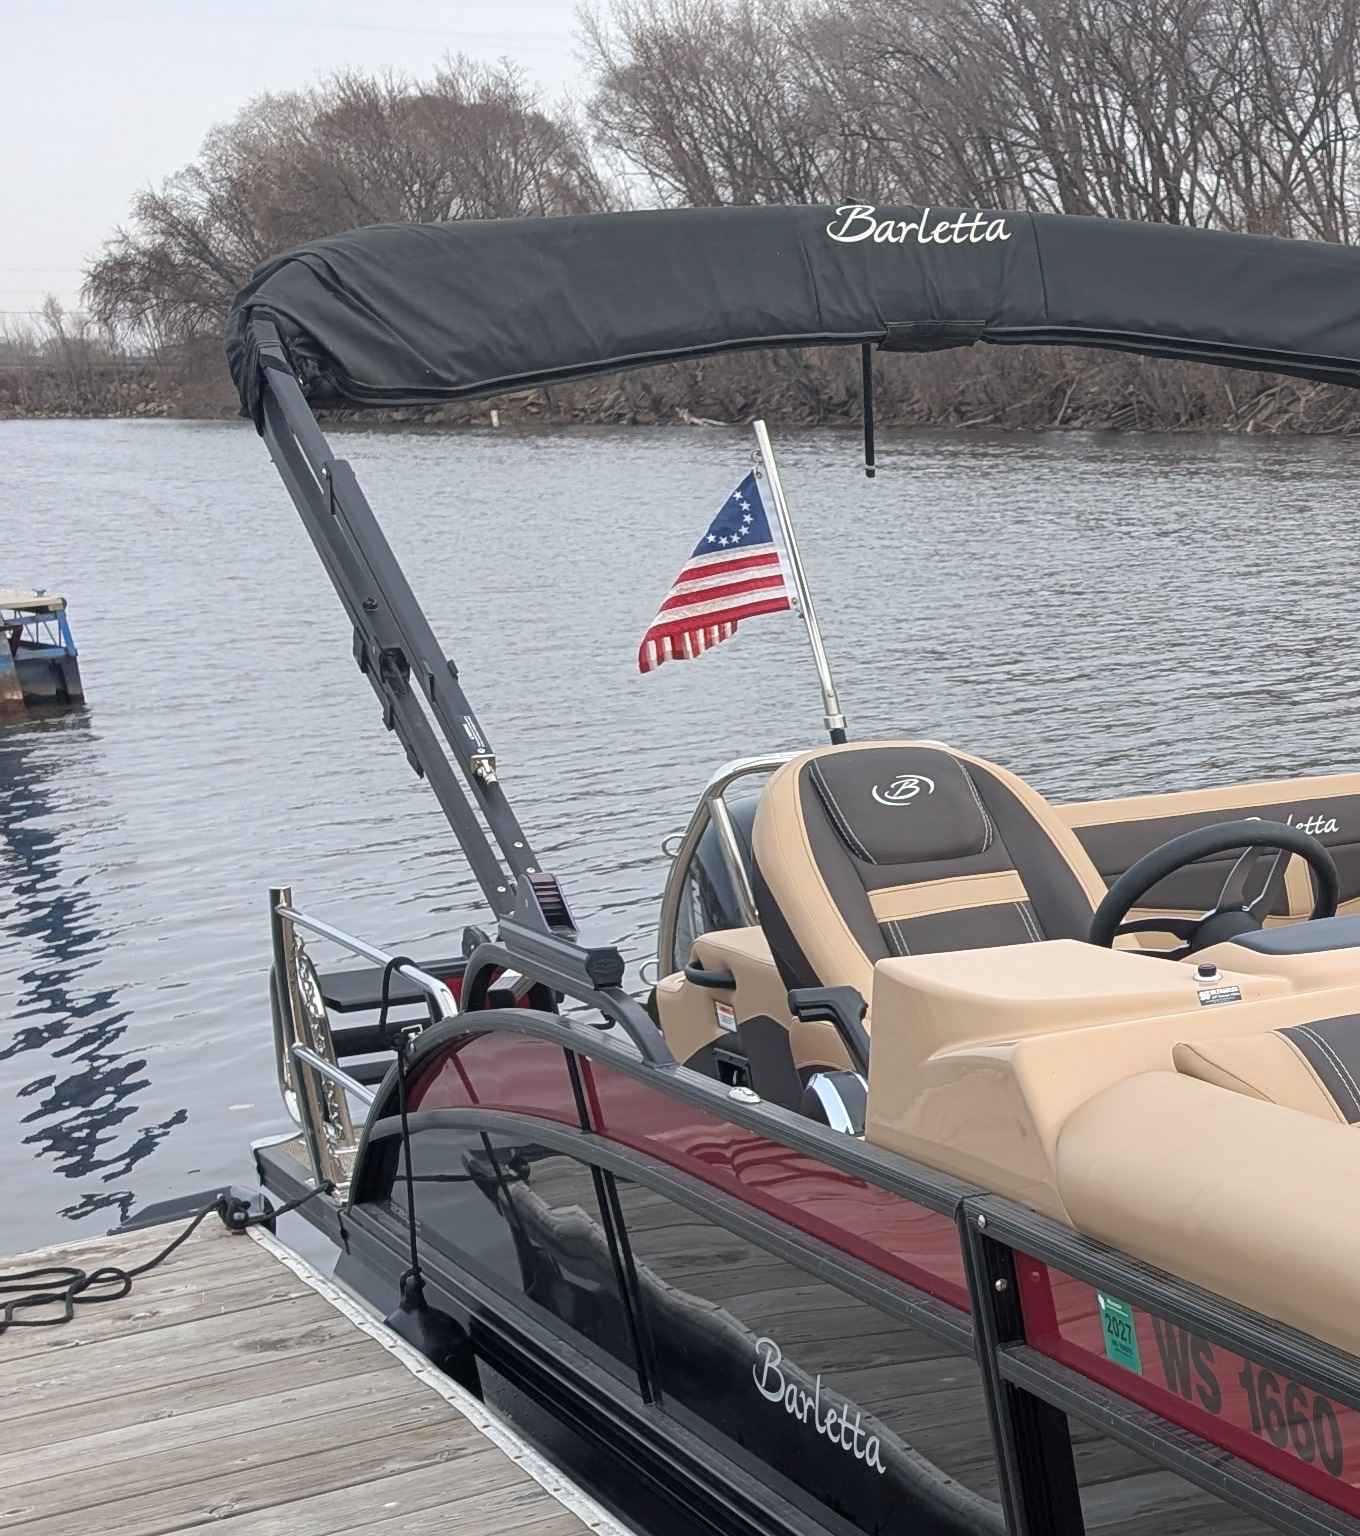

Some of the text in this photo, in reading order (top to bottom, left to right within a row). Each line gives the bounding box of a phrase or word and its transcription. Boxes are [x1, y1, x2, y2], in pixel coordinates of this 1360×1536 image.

[826, 204, 1012, 244] Barletta
[1105, 1312, 1132, 1345] 2027
[753, 1337, 886, 1475] Barletta
[1151, 1316, 1222, 1415] WS
[1239, 1360, 1343, 1477] 1660
